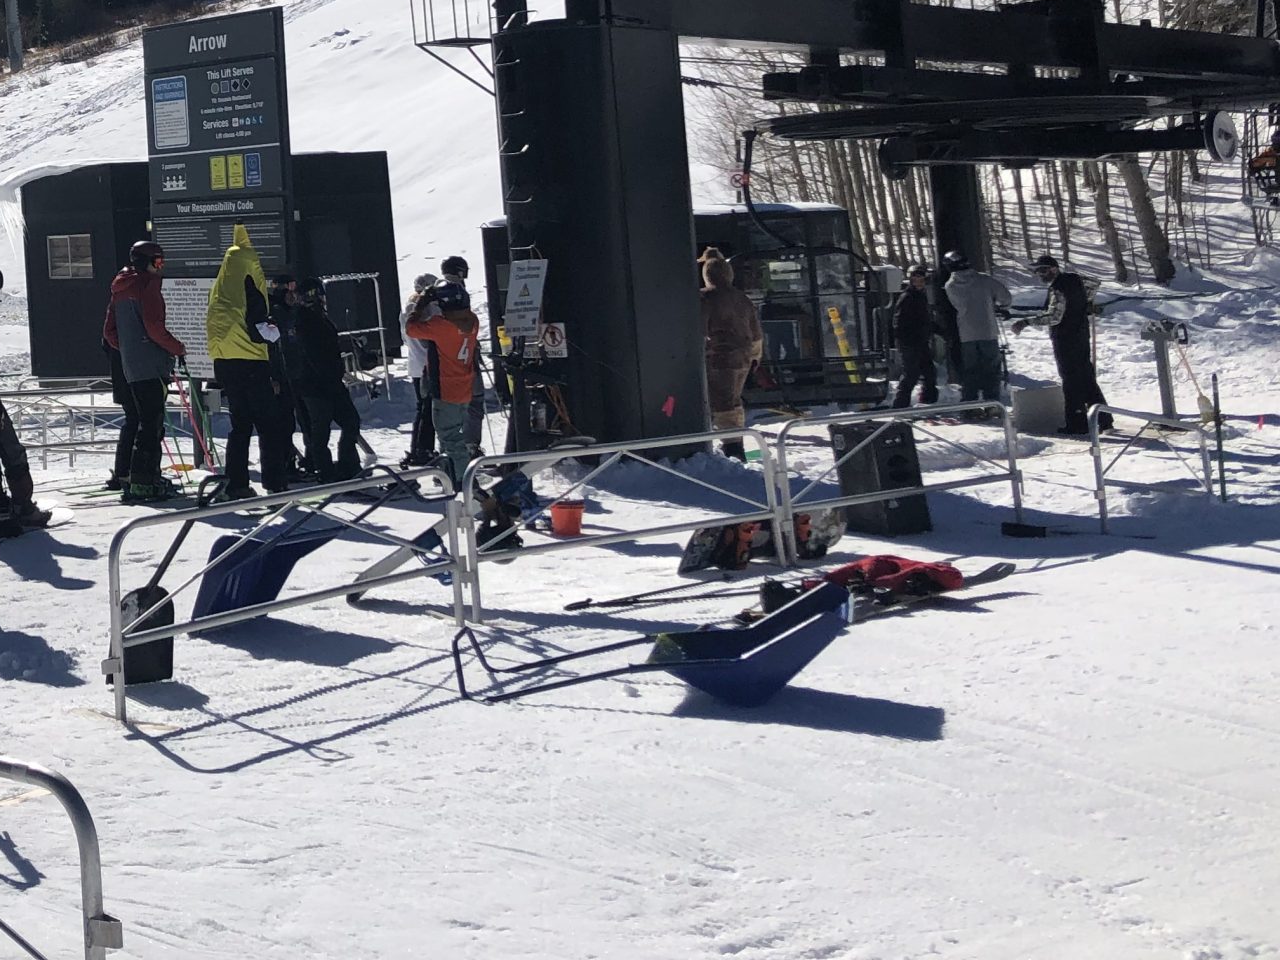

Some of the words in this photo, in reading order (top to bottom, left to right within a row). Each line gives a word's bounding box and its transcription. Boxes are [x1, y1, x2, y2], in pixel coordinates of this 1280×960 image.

[188, 34, 227, 54] Arrow
[206, 69, 220, 81] This
[221, 67, 232, 79] Lift
[232, 65, 254, 77] Serves
[202, 117, 229, 130] Services
[176, 203, 190, 213] Your
[192, 200, 236, 214] Responsibility
[237, 200, 254, 210] Code
[458, 337, 469, 364] 4
